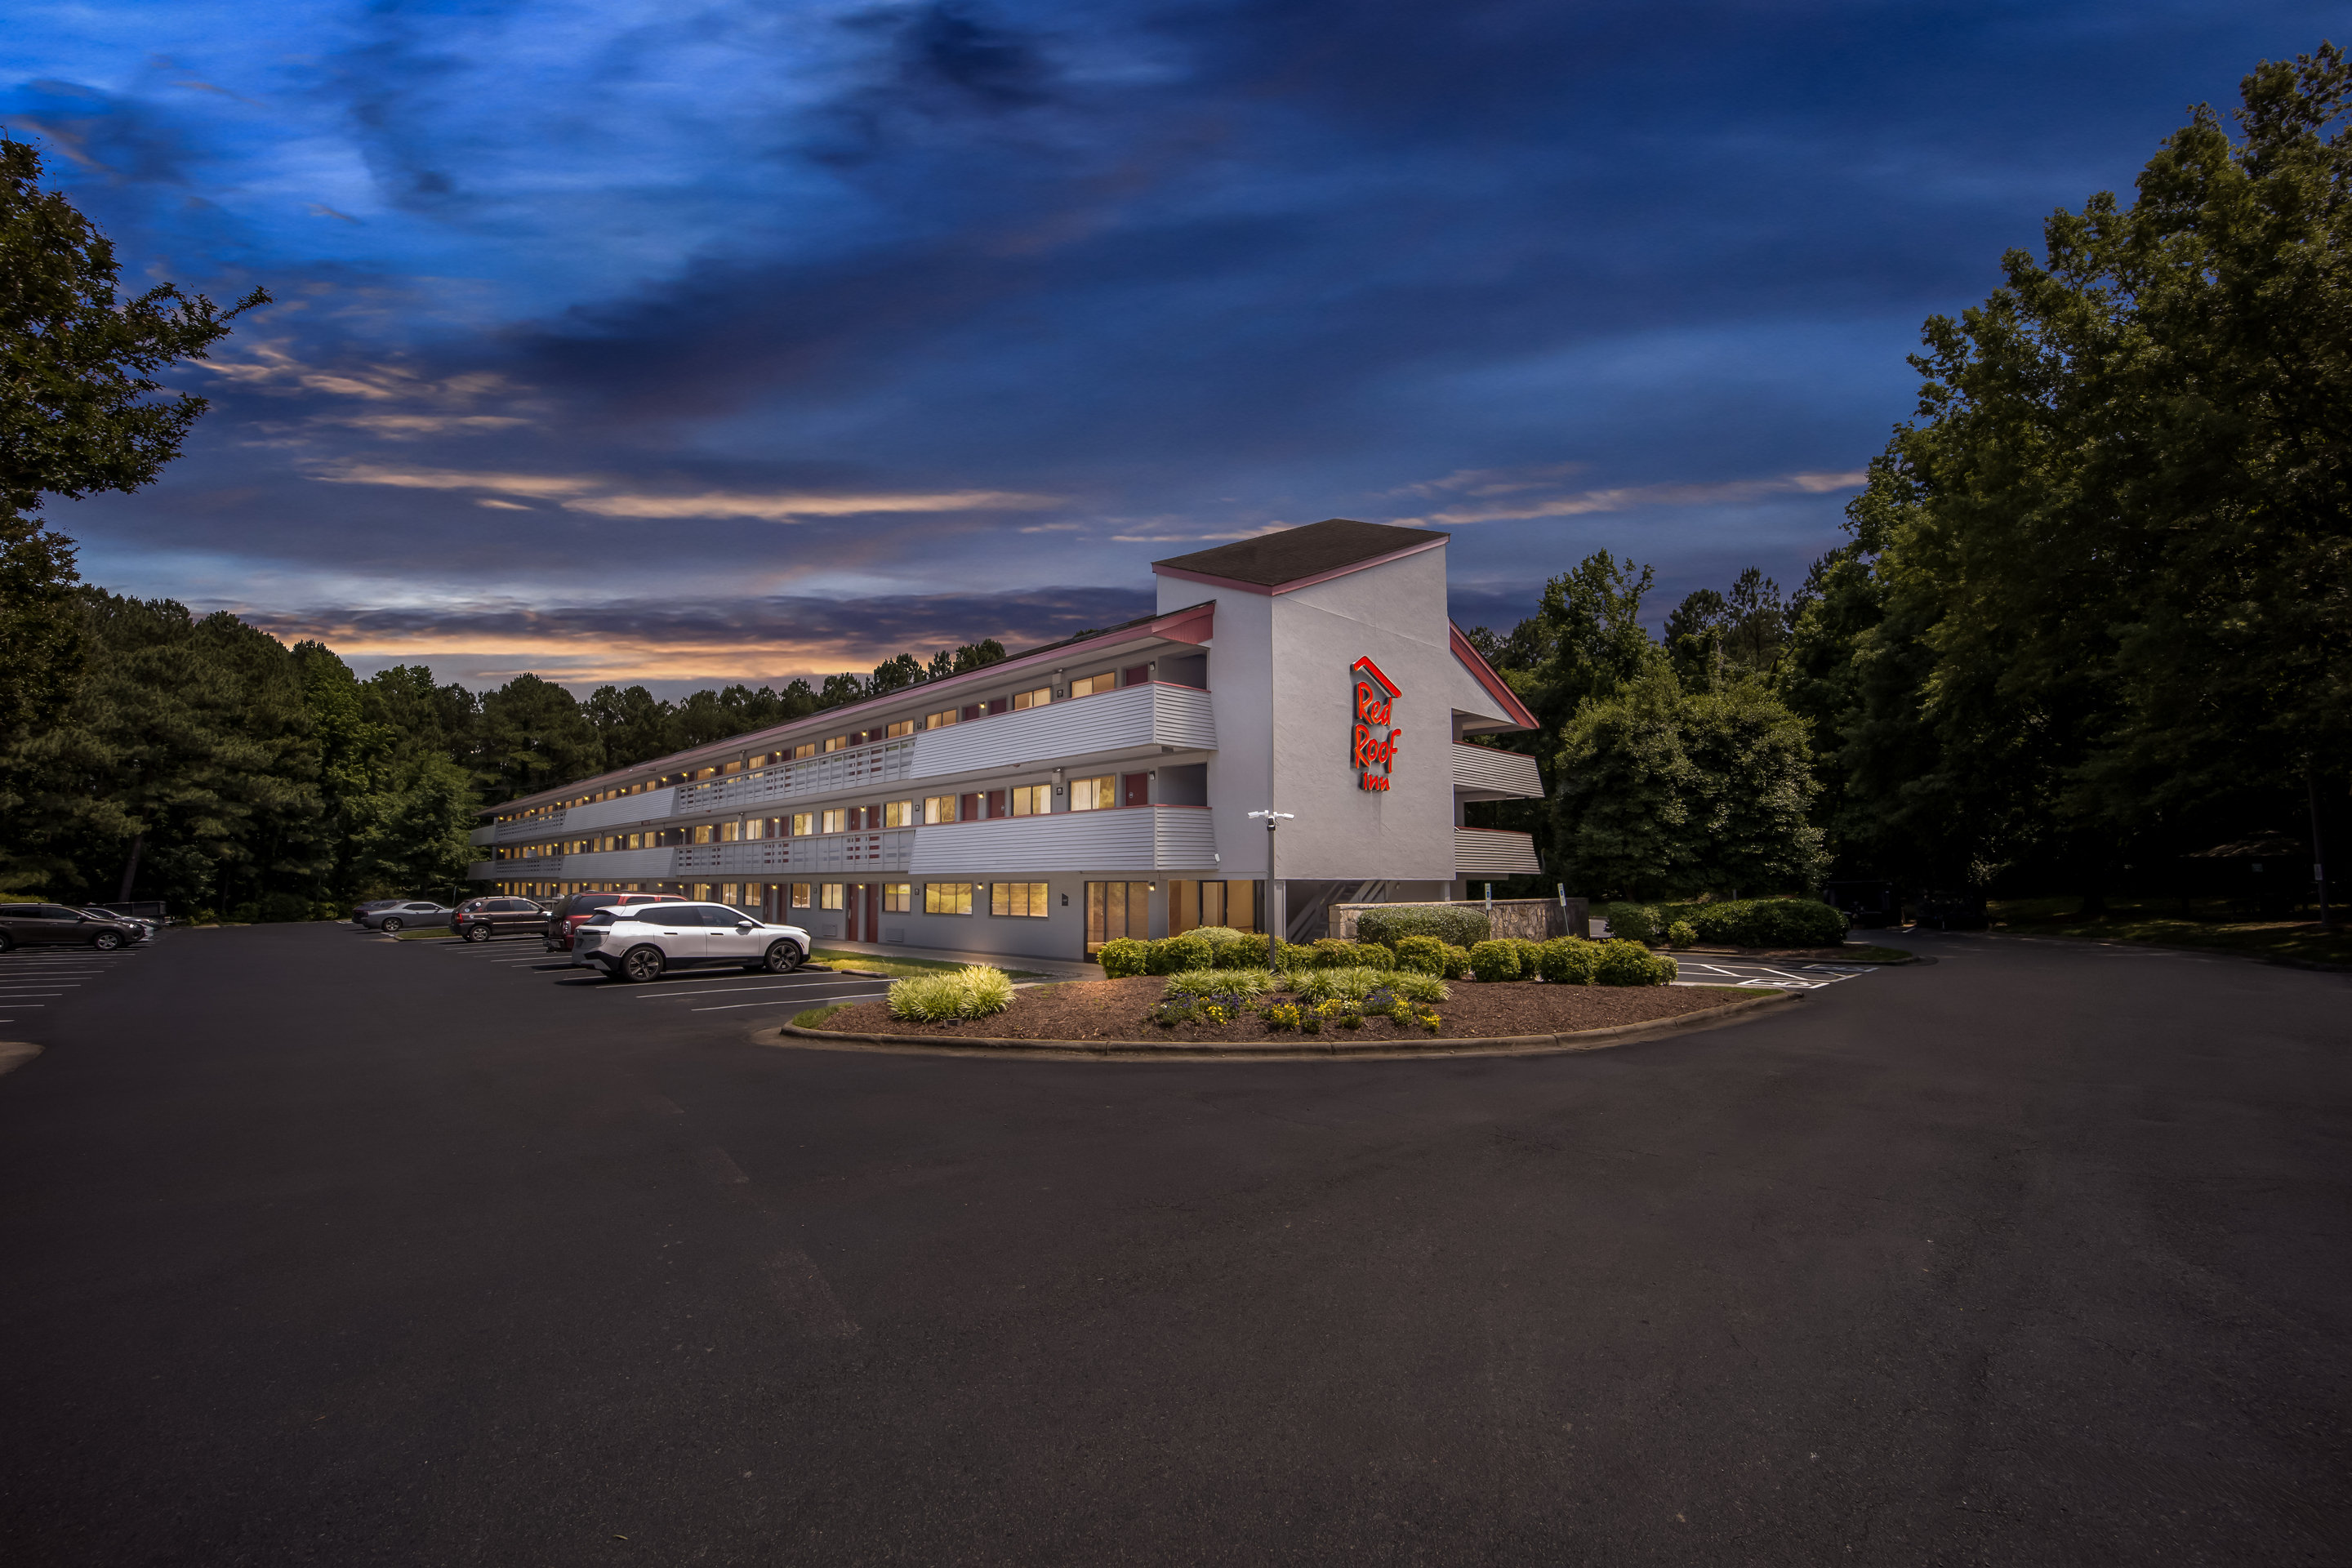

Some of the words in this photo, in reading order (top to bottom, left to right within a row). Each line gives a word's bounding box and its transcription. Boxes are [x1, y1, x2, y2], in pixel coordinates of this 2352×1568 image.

[1357, 681, 1392, 726] Red
[1355, 724, 1402, 774] Roof
[1364, 772, 1391, 791] Inn
